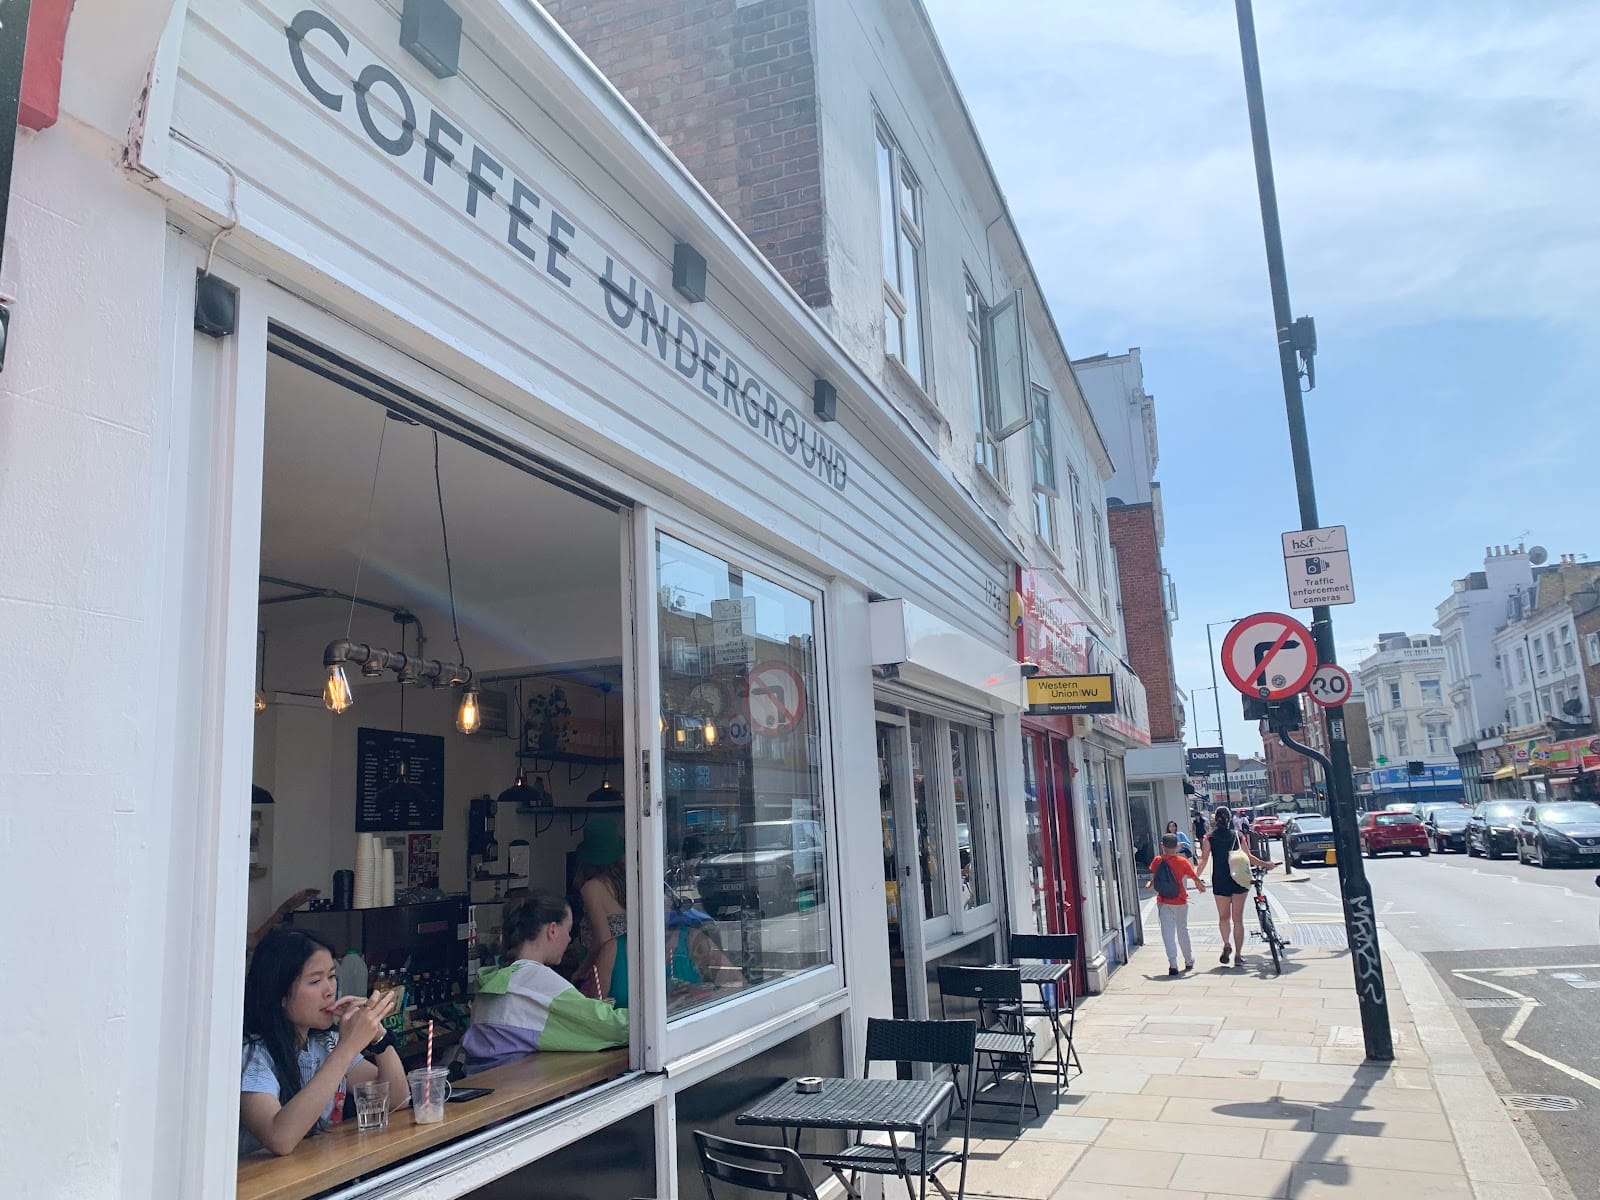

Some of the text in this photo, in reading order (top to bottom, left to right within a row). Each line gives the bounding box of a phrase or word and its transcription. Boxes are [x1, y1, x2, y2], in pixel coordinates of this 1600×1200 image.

[285, 9, 848, 493] COFFEE UNDERGROUND
[1292, 536, 1315, 550] h&f
[1304, 578, 1335, 586] Traffic
[1292, 584, 1350, 597] enforcement
[1303, 595, 1342, 604] cameras
[1038, 681, 1078, 690] Western
[1313, 675, 1345, 695] 20
[1051, 688, 1098, 698] Union WU
